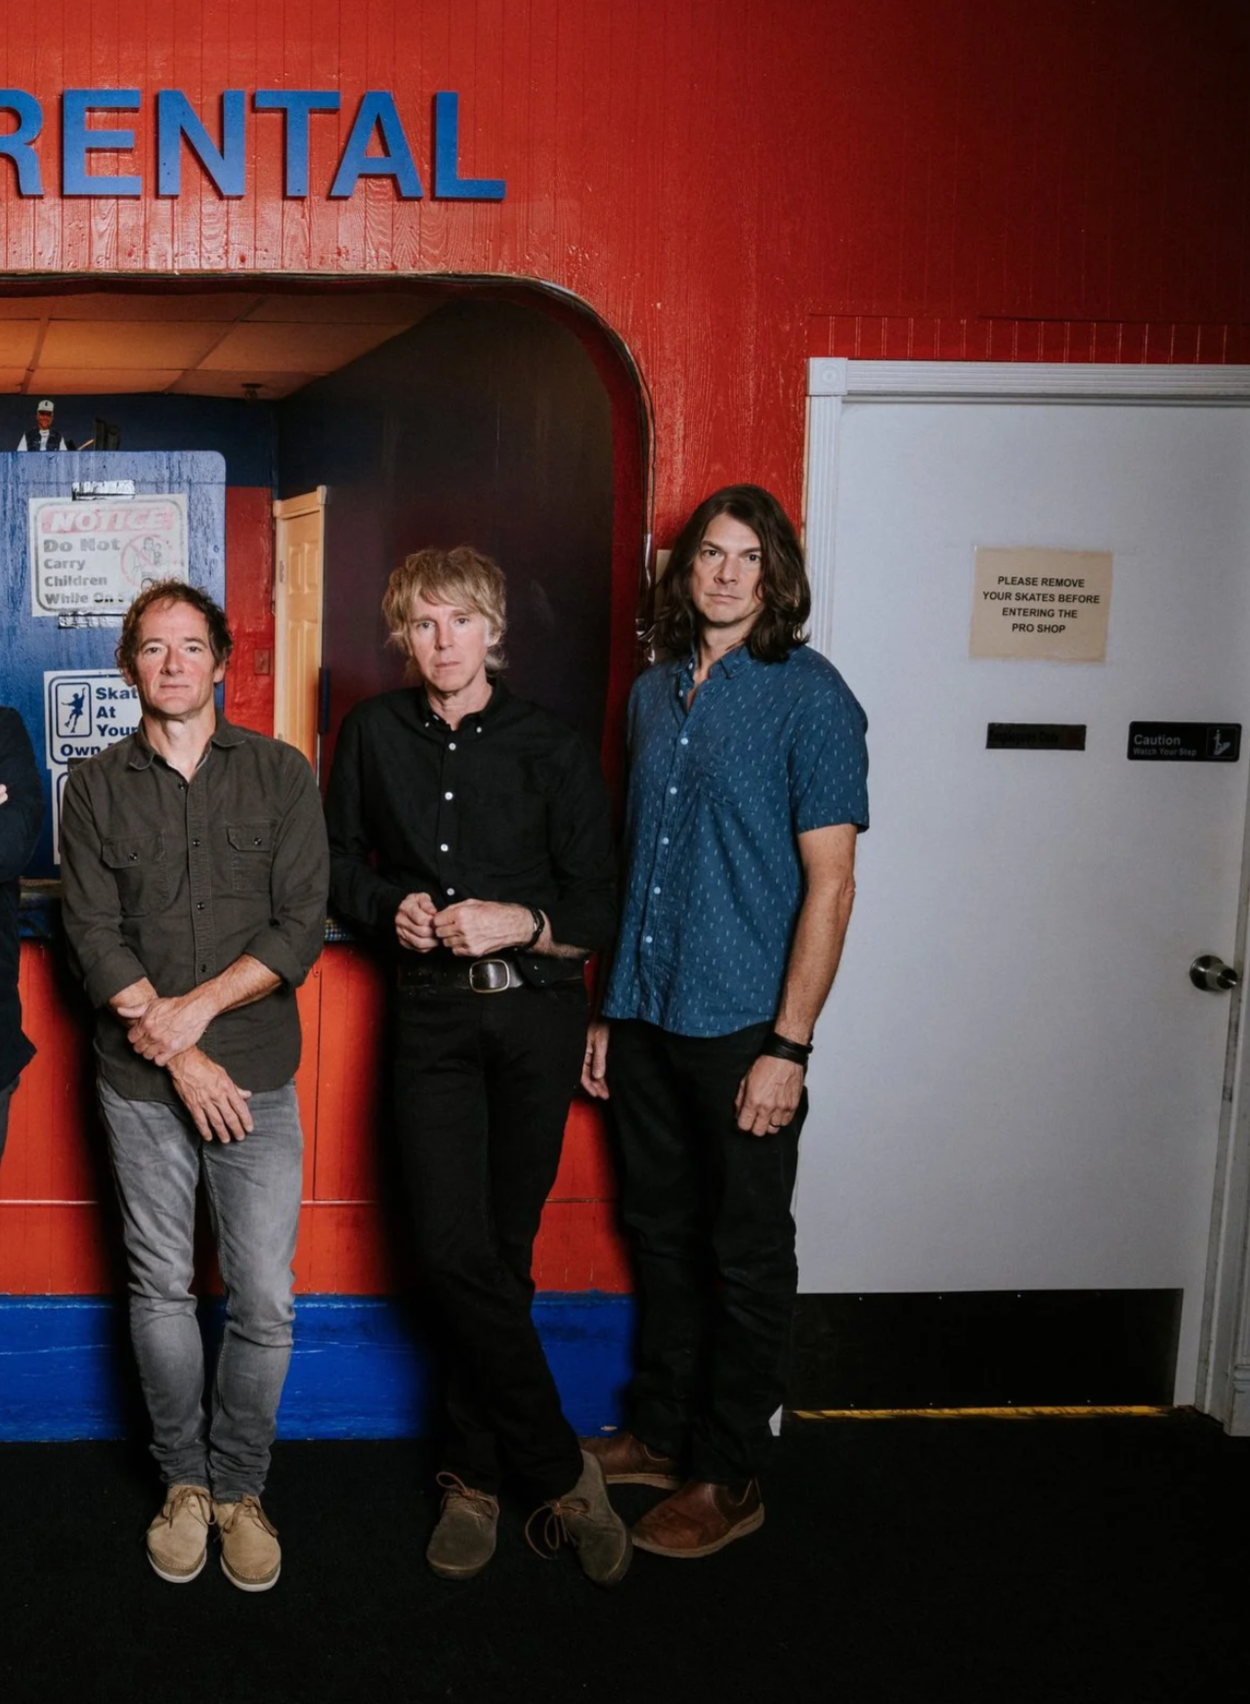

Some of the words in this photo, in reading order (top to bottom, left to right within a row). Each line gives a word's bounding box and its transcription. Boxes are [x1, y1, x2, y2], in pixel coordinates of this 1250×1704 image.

[52, 509, 171, 532] NOTICE
[44, 539, 73, 553] Do
[80, 538, 120, 552] Not
[44, 558, 86, 571] Carry
[44, 574, 108, 587] Children
[998, 576, 1038, 586] PLEASE
[1041, 578, 1085, 588] REMOVE
[44, 592, 88, 605] While
[982, 592, 1012, 600] YOUR
[1014, 592, 1056, 602] SKATES
[1058, 594, 1100, 604] BEFORE
[1002, 607, 1055, 618] ENTERING
[1058, 609, 1078, 618] THE
[1012, 623, 1034, 632] PRO
[1037, 624, 1066, 634] SHOP
[96, 687, 138, 700] Skat
[96, 706, 116, 718] At
[96, 724, 138, 736] Your
[1134, 734, 1182, 746] Caution
[60, 744, 101, 756] Own
[1133, 748, 1157, 756] Watch
[1160, 748, 1178, 756] Your
[1178, 748, 1198, 757] Step
